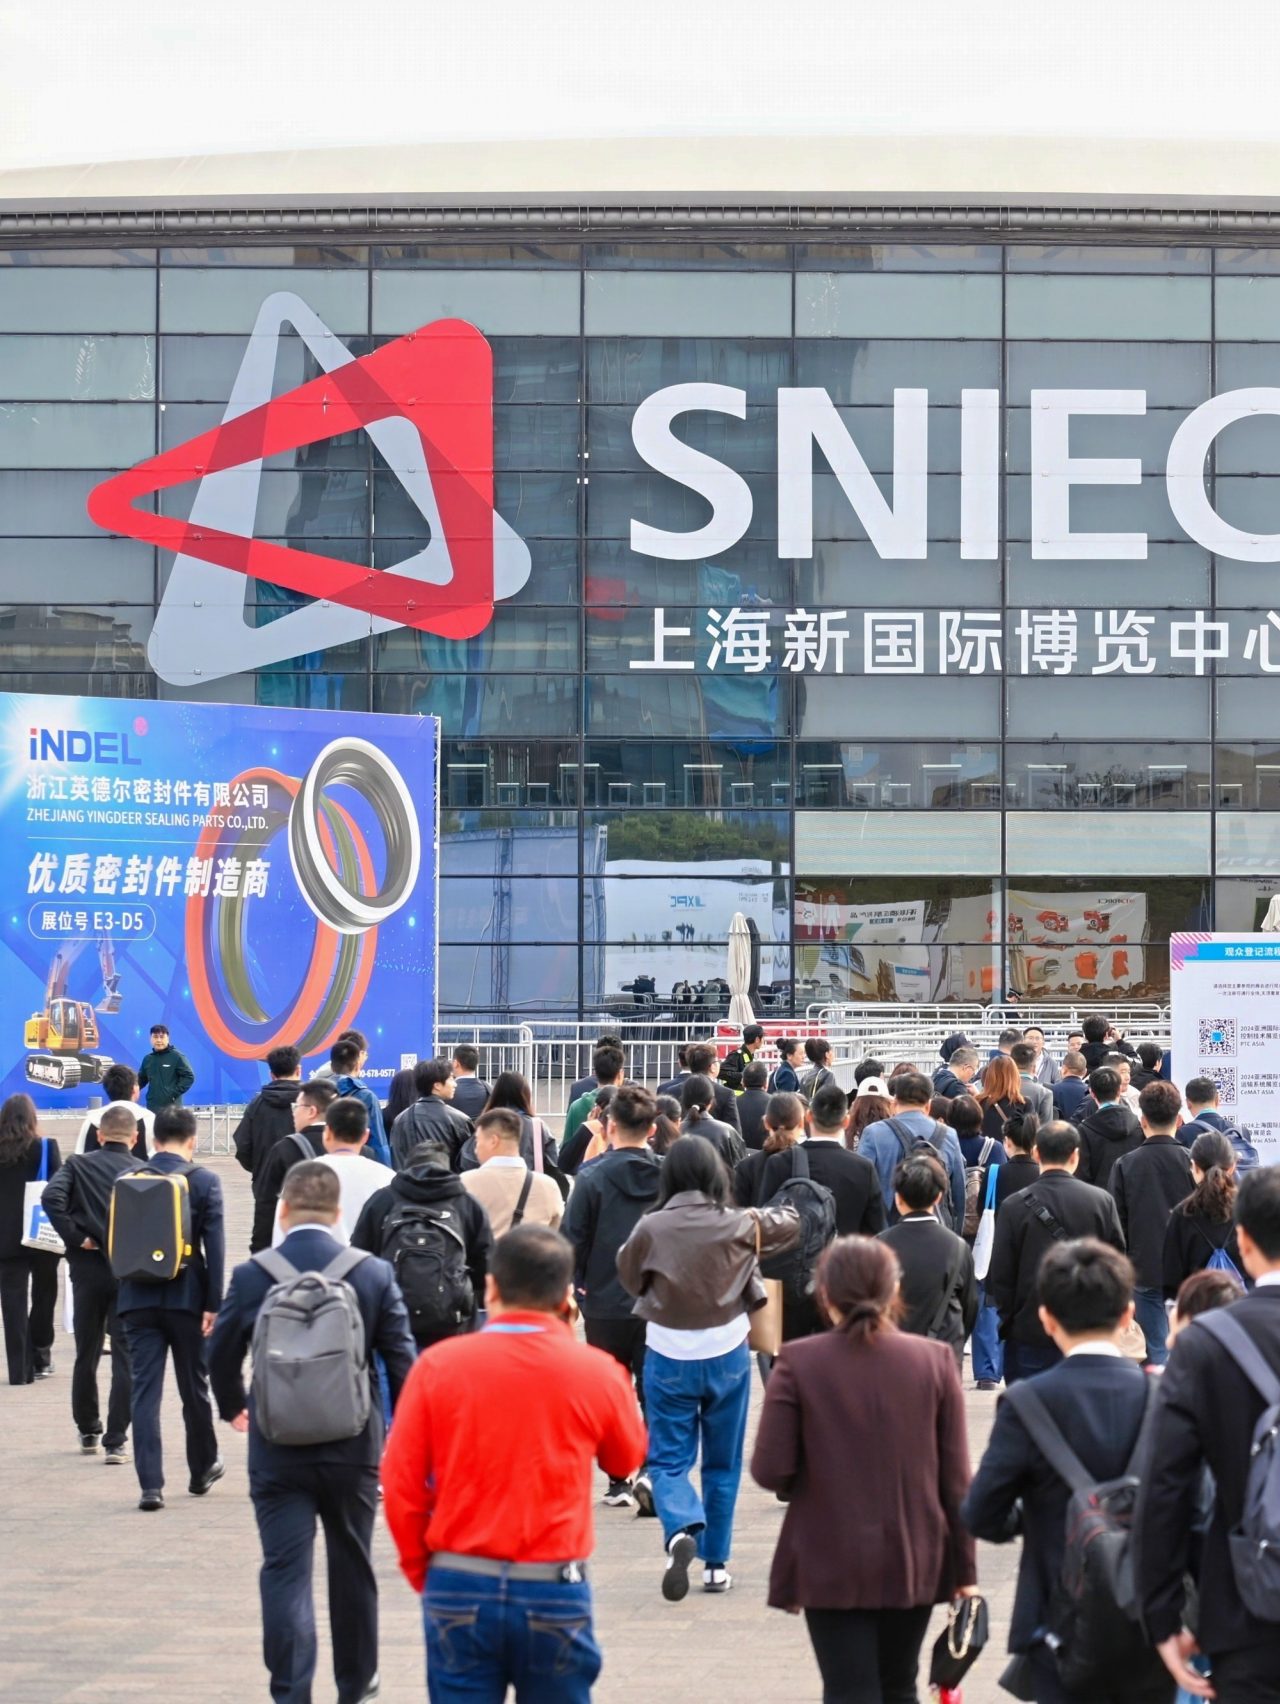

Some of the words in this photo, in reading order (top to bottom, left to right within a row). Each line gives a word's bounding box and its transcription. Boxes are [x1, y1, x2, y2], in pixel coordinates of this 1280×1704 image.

[27, 773, 269, 809] 浙江英德尔密封件有限公司
[27, 808, 84, 823] ZHEJIANG
[87, 810, 142, 825] YINGDEER
[145, 812, 190, 827] SEALING
[192, 814, 225, 828] PARTS
[27, 851, 271, 898] 优质密封件制造商
[41, 911, 89, 931] 展位号
[94, 911, 143, 931] E3-D5
[358, 1069, 396, 1078] 0-678-0577
